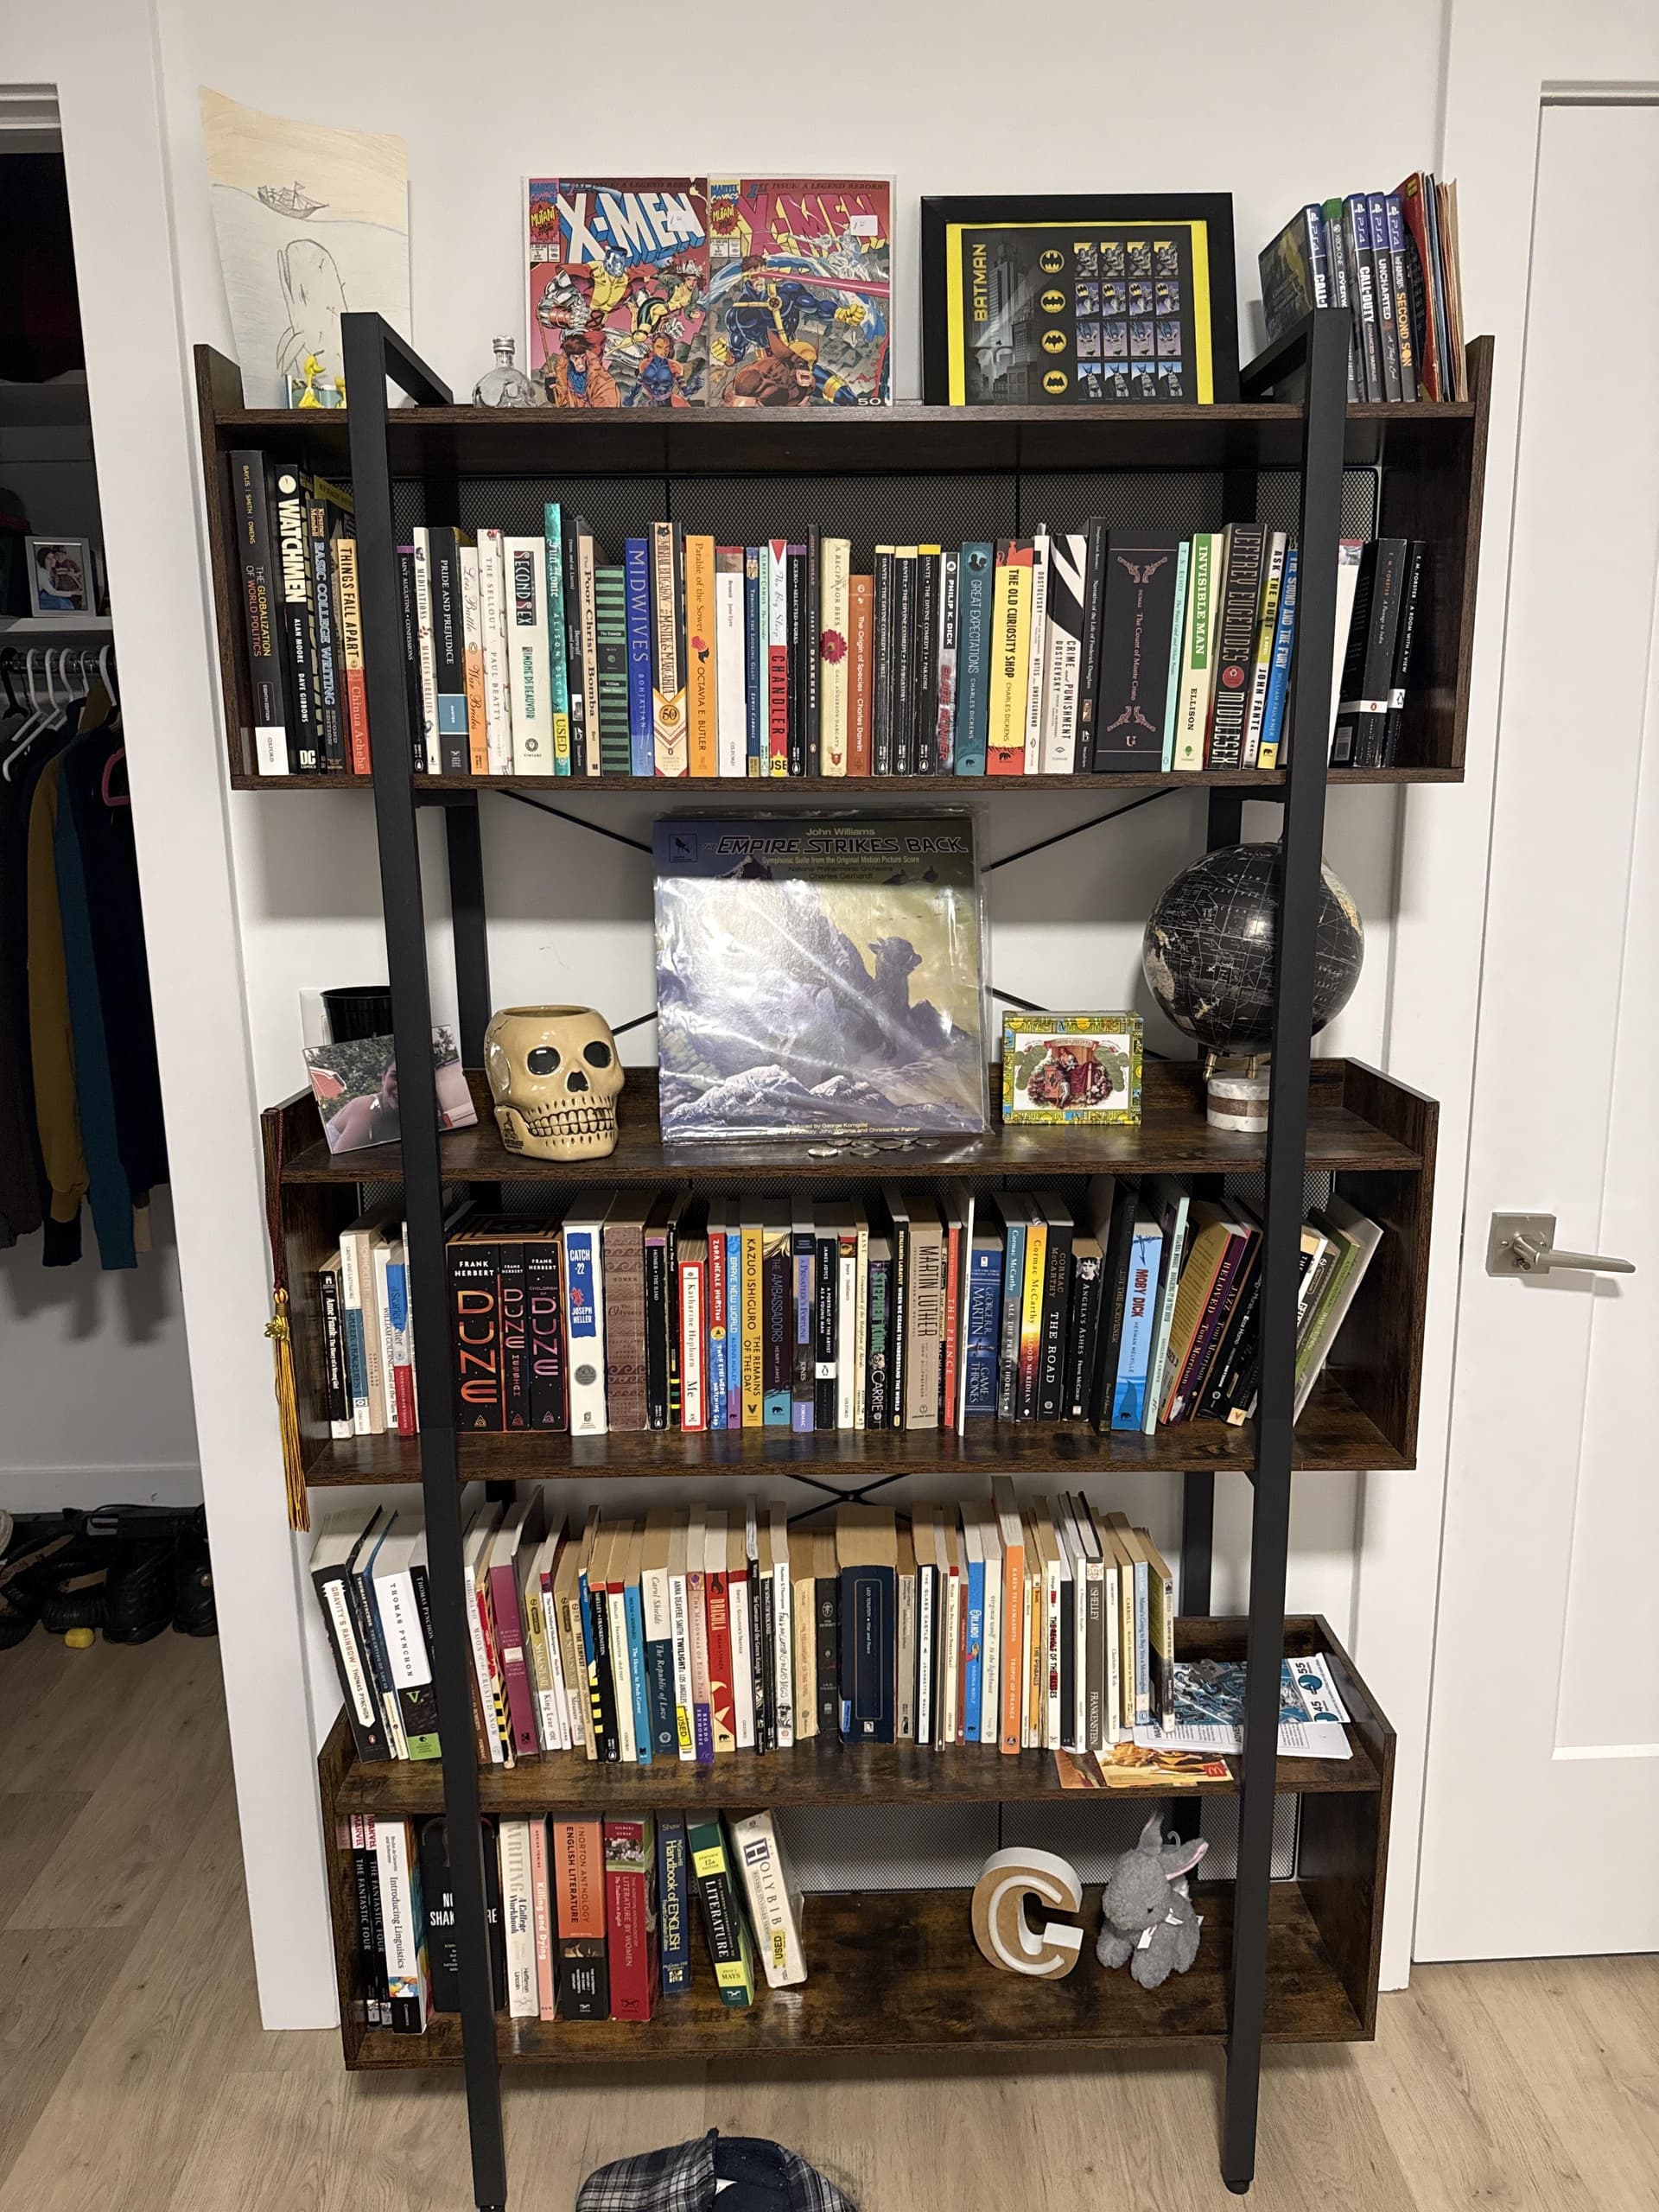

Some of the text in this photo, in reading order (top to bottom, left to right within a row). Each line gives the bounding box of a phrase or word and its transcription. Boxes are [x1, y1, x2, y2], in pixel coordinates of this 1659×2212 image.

[710, 184, 739, 195] MARVEL
[531, 207, 556, 227] MUTANT
[555, 193, 706, 264] X-MEN
[737, 193, 887, 257] X-MEN
[972, 243, 988, 322] BATMAN
[1378, 258, 1391, 320] UNCHARTED
[1397, 292, 1409, 340] SECOND
[278, 499, 307, 603] WATCHMEN
[441, 559, 450, 589] PRIDE
[340, 548, 359, 658] THINGS FALL APART
[416, 568, 428, 620] MEDITATIONS
[514, 550, 533, 626] SECOND SEX
[629, 550, 648, 662] MIDWIVES
[696, 576, 704, 586] of
[1195, 546, 1208, 655] INVISIBLE MAN
[1223, 529, 1262, 662] JEFFREY EUGENIDES
[1264, 550, 1282, 629] ASK THE DUST
[315, 542, 327, 582] BASIC
[321, 646, 335, 706] WRITING
[443, 613, 454, 664] PREJUDICE
[586, 608, 594, 655] Christ
[968, 579, 982, 674] GREAT EXPECTATIONS
[1004, 569, 1020, 678] THE OLD CURIOSITY SHOP
[588, 667, 596, 716] Bomba
[1052, 641, 1064, 692] DOSTOEVSKY
[1062, 640, 1077, 740] CRIME PUNISHMENT
[772, 655, 785, 734] CHANDLER
[1187, 688, 1198, 731] ELLISON
[1250, 668, 1267, 731] JOHN FANTE
[299, 750, 317, 765] DC
[355, 730, 366, 769] Achebe
[556, 718, 568, 753] USED
[715, 836, 800, 855] EMPIRE
[803, 837, 900, 854] STRIKES
[906, 837, 969, 854] BACK
[806, 827, 875, 836] John Williams
[761, 856, 794, 865] Symphonic
[569, 1249, 591, 1262] CATCH
[1010, 1230, 1020, 1258] Cormac
[747, 1238, 756, 1331] KAZUO ISHIGURO
[918, 1246, 939, 1337] MARTIN LUTHER
[1029, 1239, 1042, 1325] Cormac McCarthy
[1057, 1253, 1065, 1294] CORMAC
[1131, 1268, 1148, 1318] MOBY DICK
[1223, 1285, 1237, 1312] JAZZ
[572, 1306, 593, 1315] JOSEPH
[573, 1315, 592, 1324] HELLER
[971, 1287, 984, 1335] MARTIN
[457, 1290, 497, 1403] DUNE
[531, 1297, 559, 1376] DUNE
[686, 1330, 696, 1367] Hepburn
[744, 1340, 751, 1354] OF
[1046, 1312, 1059, 1383] THE ROAD
[687, 1381, 698, 1397] Me
[871, 1370, 886, 1412] CARRIE
[970, 1363, 981, 1403] THRONES
[710, 1599, 727, 1631] DRACULA
[1090, 1587, 1099, 1622] SHELLEY
[330, 1586, 370, 1719] GRAVITY'S RAINBOW THOMAS PYNCHON
[391, 1583, 412, 1677] THOMAS PYNCHON
[1297, 1662, 1307, 1674] 55
[406, 1690, 424, 1704] V.
[1090, 1691, 1099, 1745] FRANKENSTEIN
[1313, 1700, 1324, 1712] 45
[677, 1716, 688, 1738] USED
[566, 1826, 579, 1923] ENGLISH LITERATURE
[665, 1840, 678, 1892] Handbook
[358, 1878, 372, 1951] FANTASTIC FOUR
[536, 1882, 544, 1912] Killing
[581, 1871, 589, 1923] ANTHOLOGY
[704, 1880, 730, 1958] LITERATURE
[970, 1847, 1084, 1980] C
[390, 1877, 404, 1969] Introducing Linguistics
[538, 1934, 548, 1961] Dying
[668, 1903, 681, 1951] ENGLISH
[774, 1935, 784, 1961] USED
